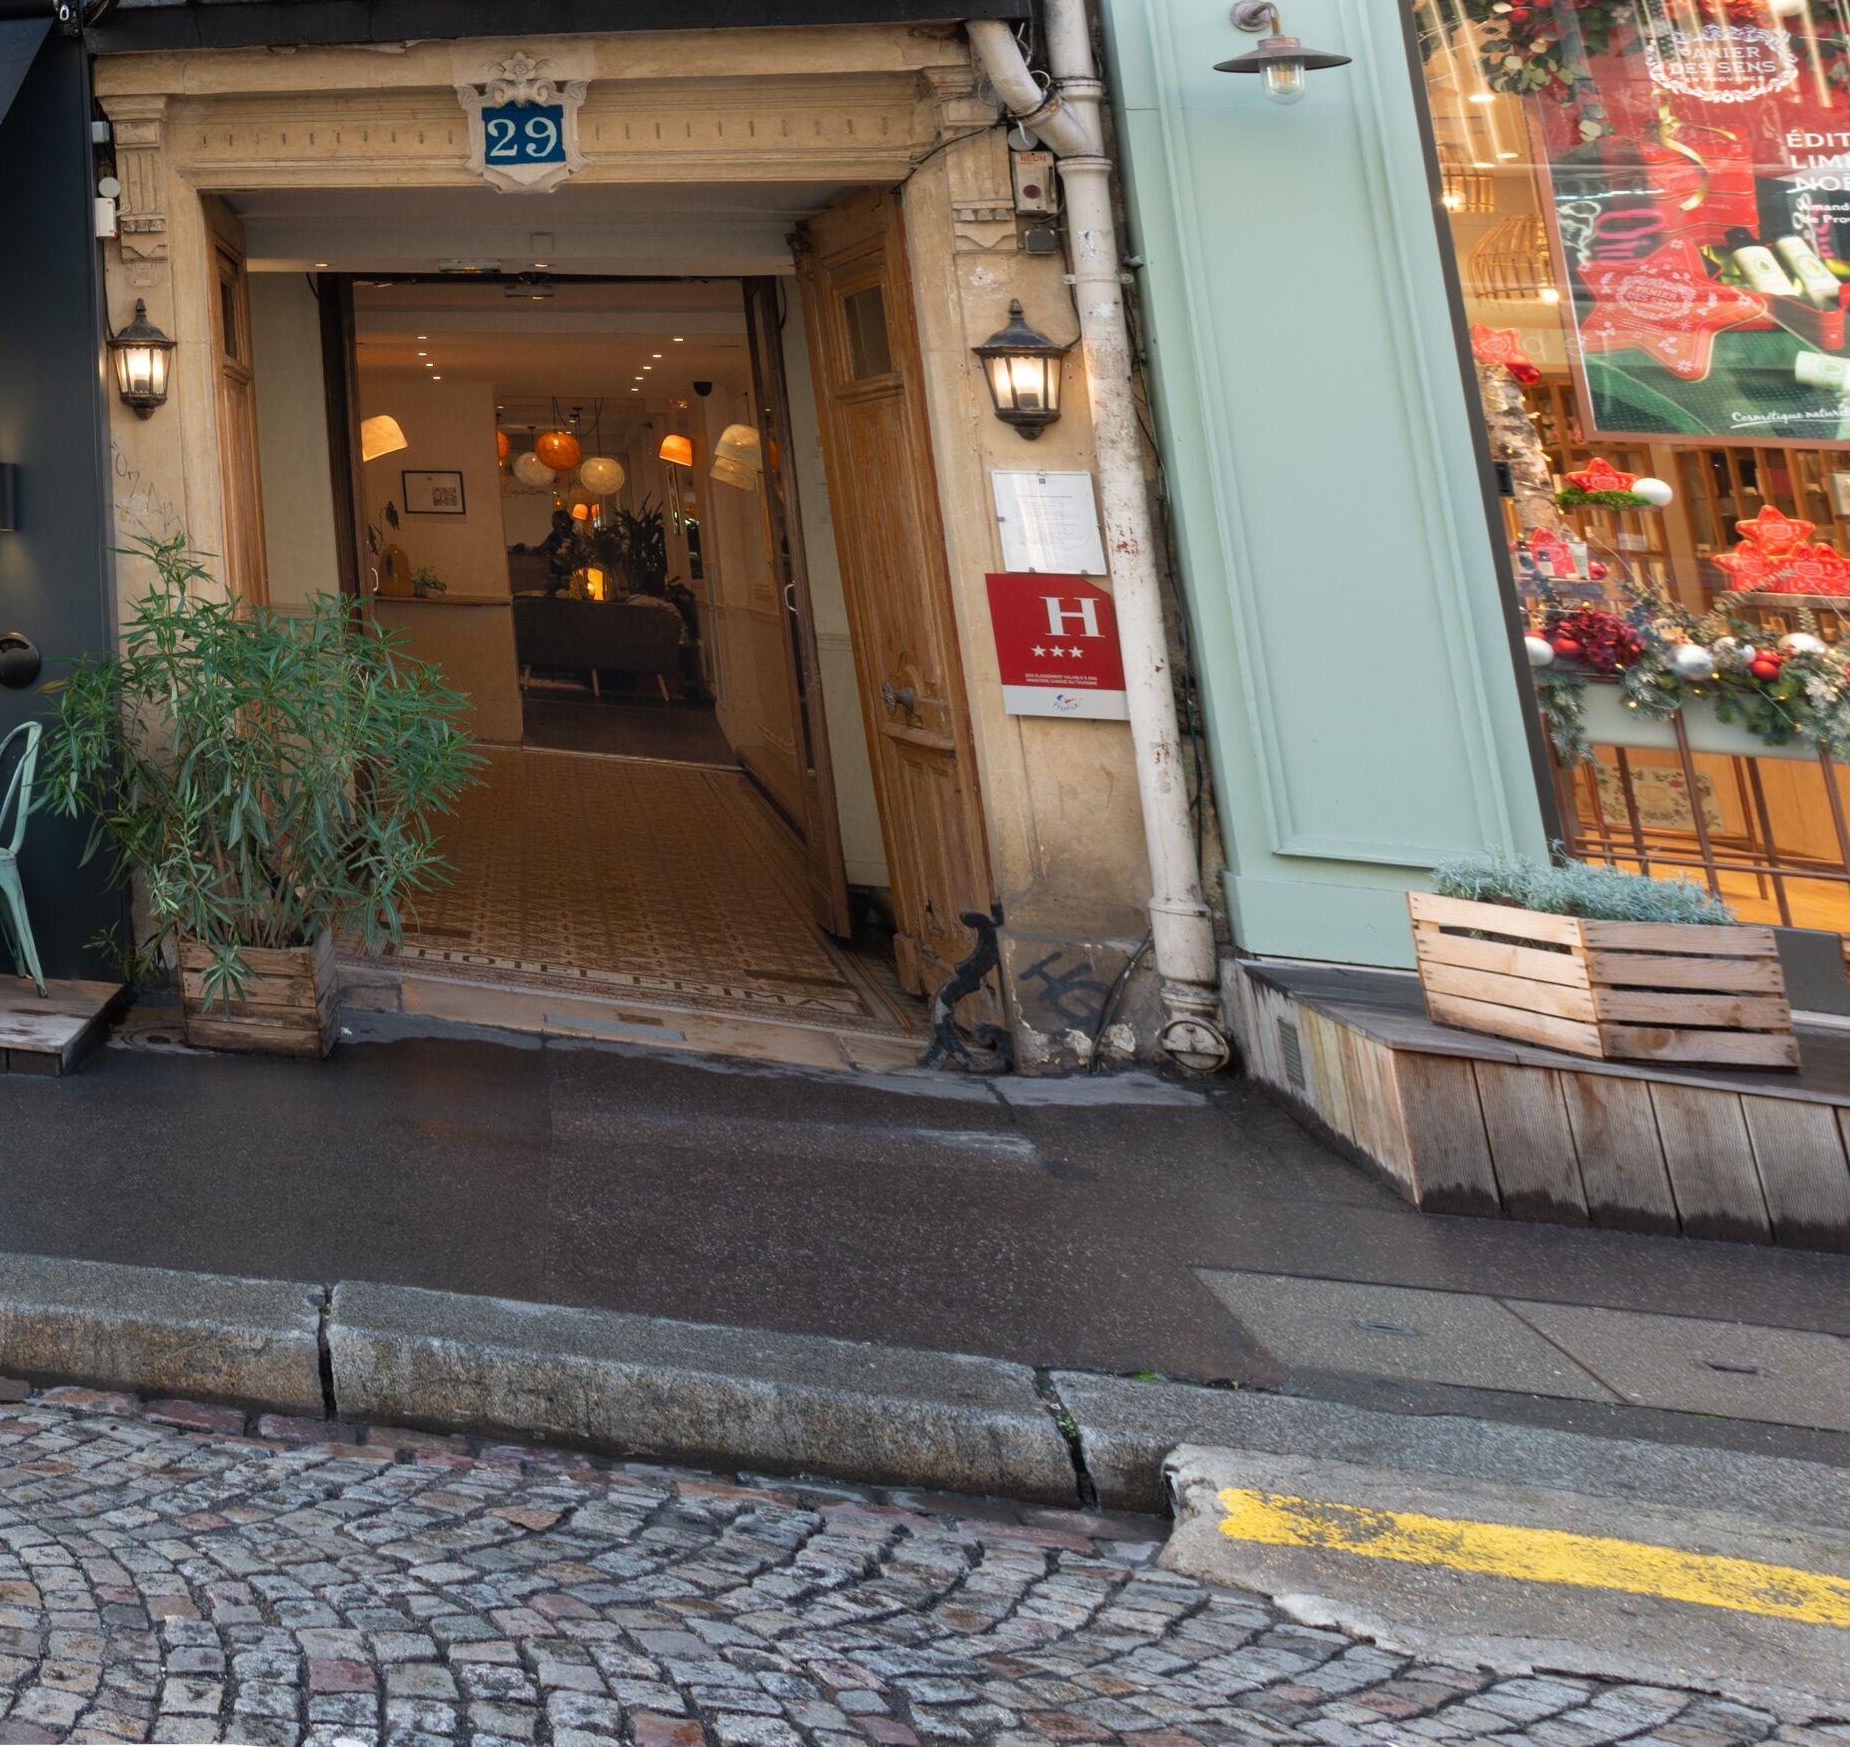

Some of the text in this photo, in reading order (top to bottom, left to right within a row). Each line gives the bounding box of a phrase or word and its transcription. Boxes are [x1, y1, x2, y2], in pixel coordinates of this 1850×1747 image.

[1669, 61, 1776, 74] DES SENS
[487, 117, 557, 158] 29
[1039, 596, 1106, 638] H
